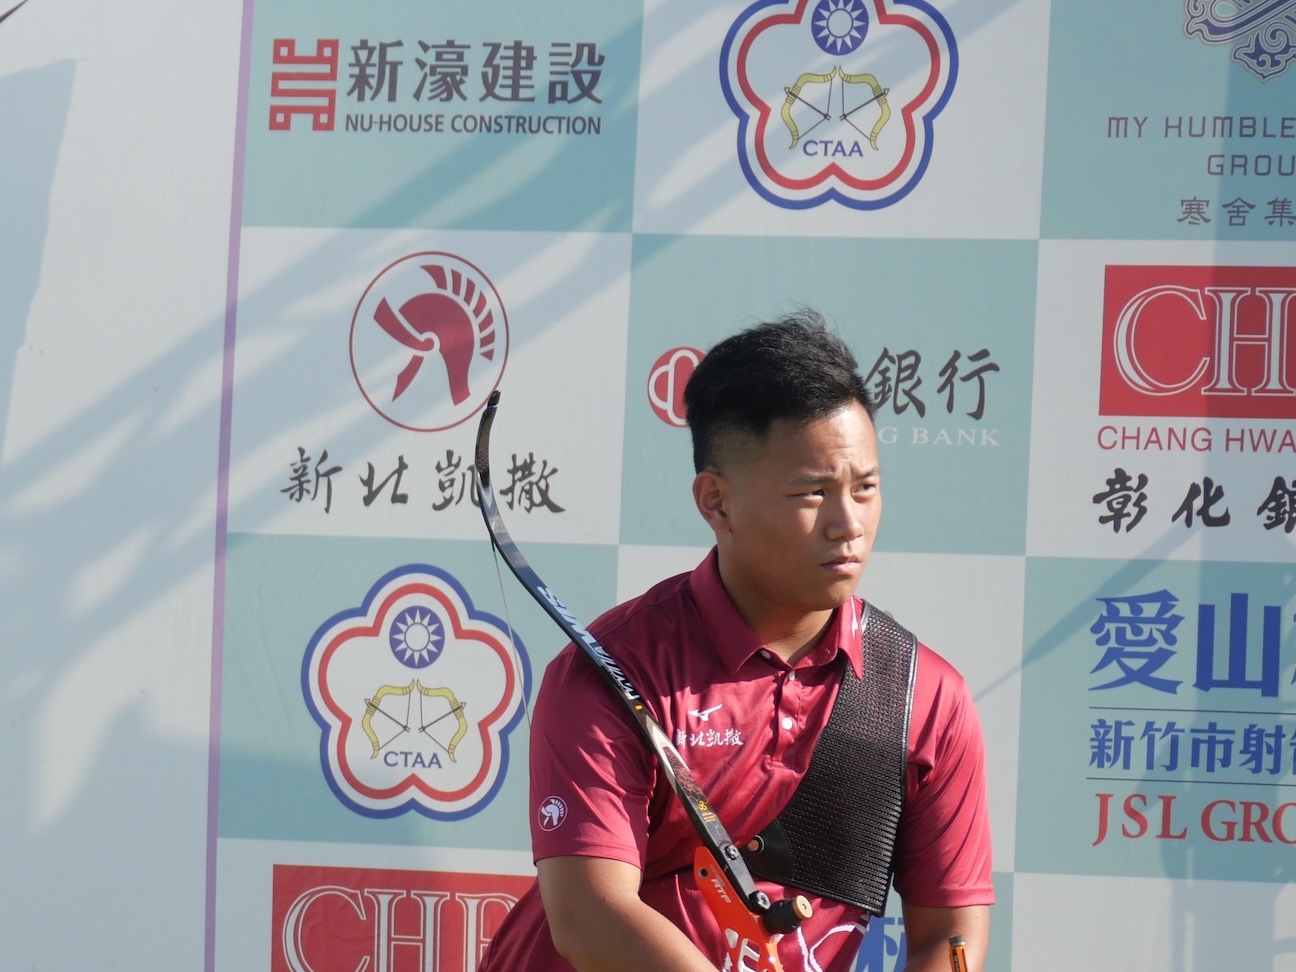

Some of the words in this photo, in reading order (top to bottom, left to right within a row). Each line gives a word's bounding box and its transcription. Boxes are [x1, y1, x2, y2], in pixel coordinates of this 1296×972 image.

[347, 39, 605, 104] 新濠建設
[345, 113, 444, 134] NU-HOUSE
[452, 114, 602, 136] CONSTRUCTION
[1107, 116, 1148, 138] MY
[802, 139, 864, 158] CTAA
[911, 427, 1001, 446] BANK
[1097, 426, 1212, 452] CHANG
[280, 446, 567, 515] 新北凱撒
[1088, 588, 1296, 698] 愛山
[1089, 718, 1296, 775] 新竹市射
[383, 751, 442, 769] CTAA
